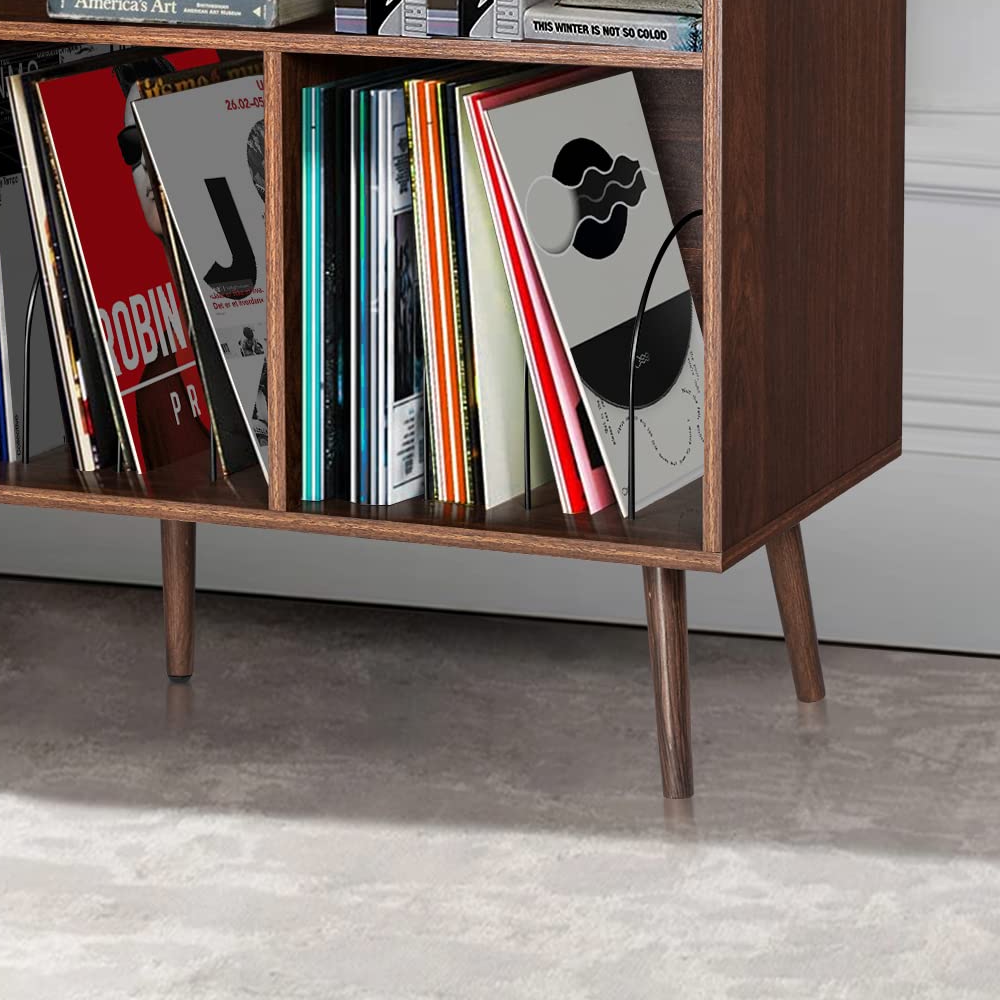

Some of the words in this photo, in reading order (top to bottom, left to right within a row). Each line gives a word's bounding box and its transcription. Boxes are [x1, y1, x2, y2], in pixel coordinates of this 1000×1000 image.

[533, 20, 554, 32] THIS
[554, 22, 590, 35] WINTER
[591, 26, 601, 36] IS
[602, 27, 620, 38] NOT
[622, 28, 636, 39] SO
[637, 29, 668, 41] COLOD
[203, 176, 257, 300] J
[99, 282, 188, 377] ROBIN
